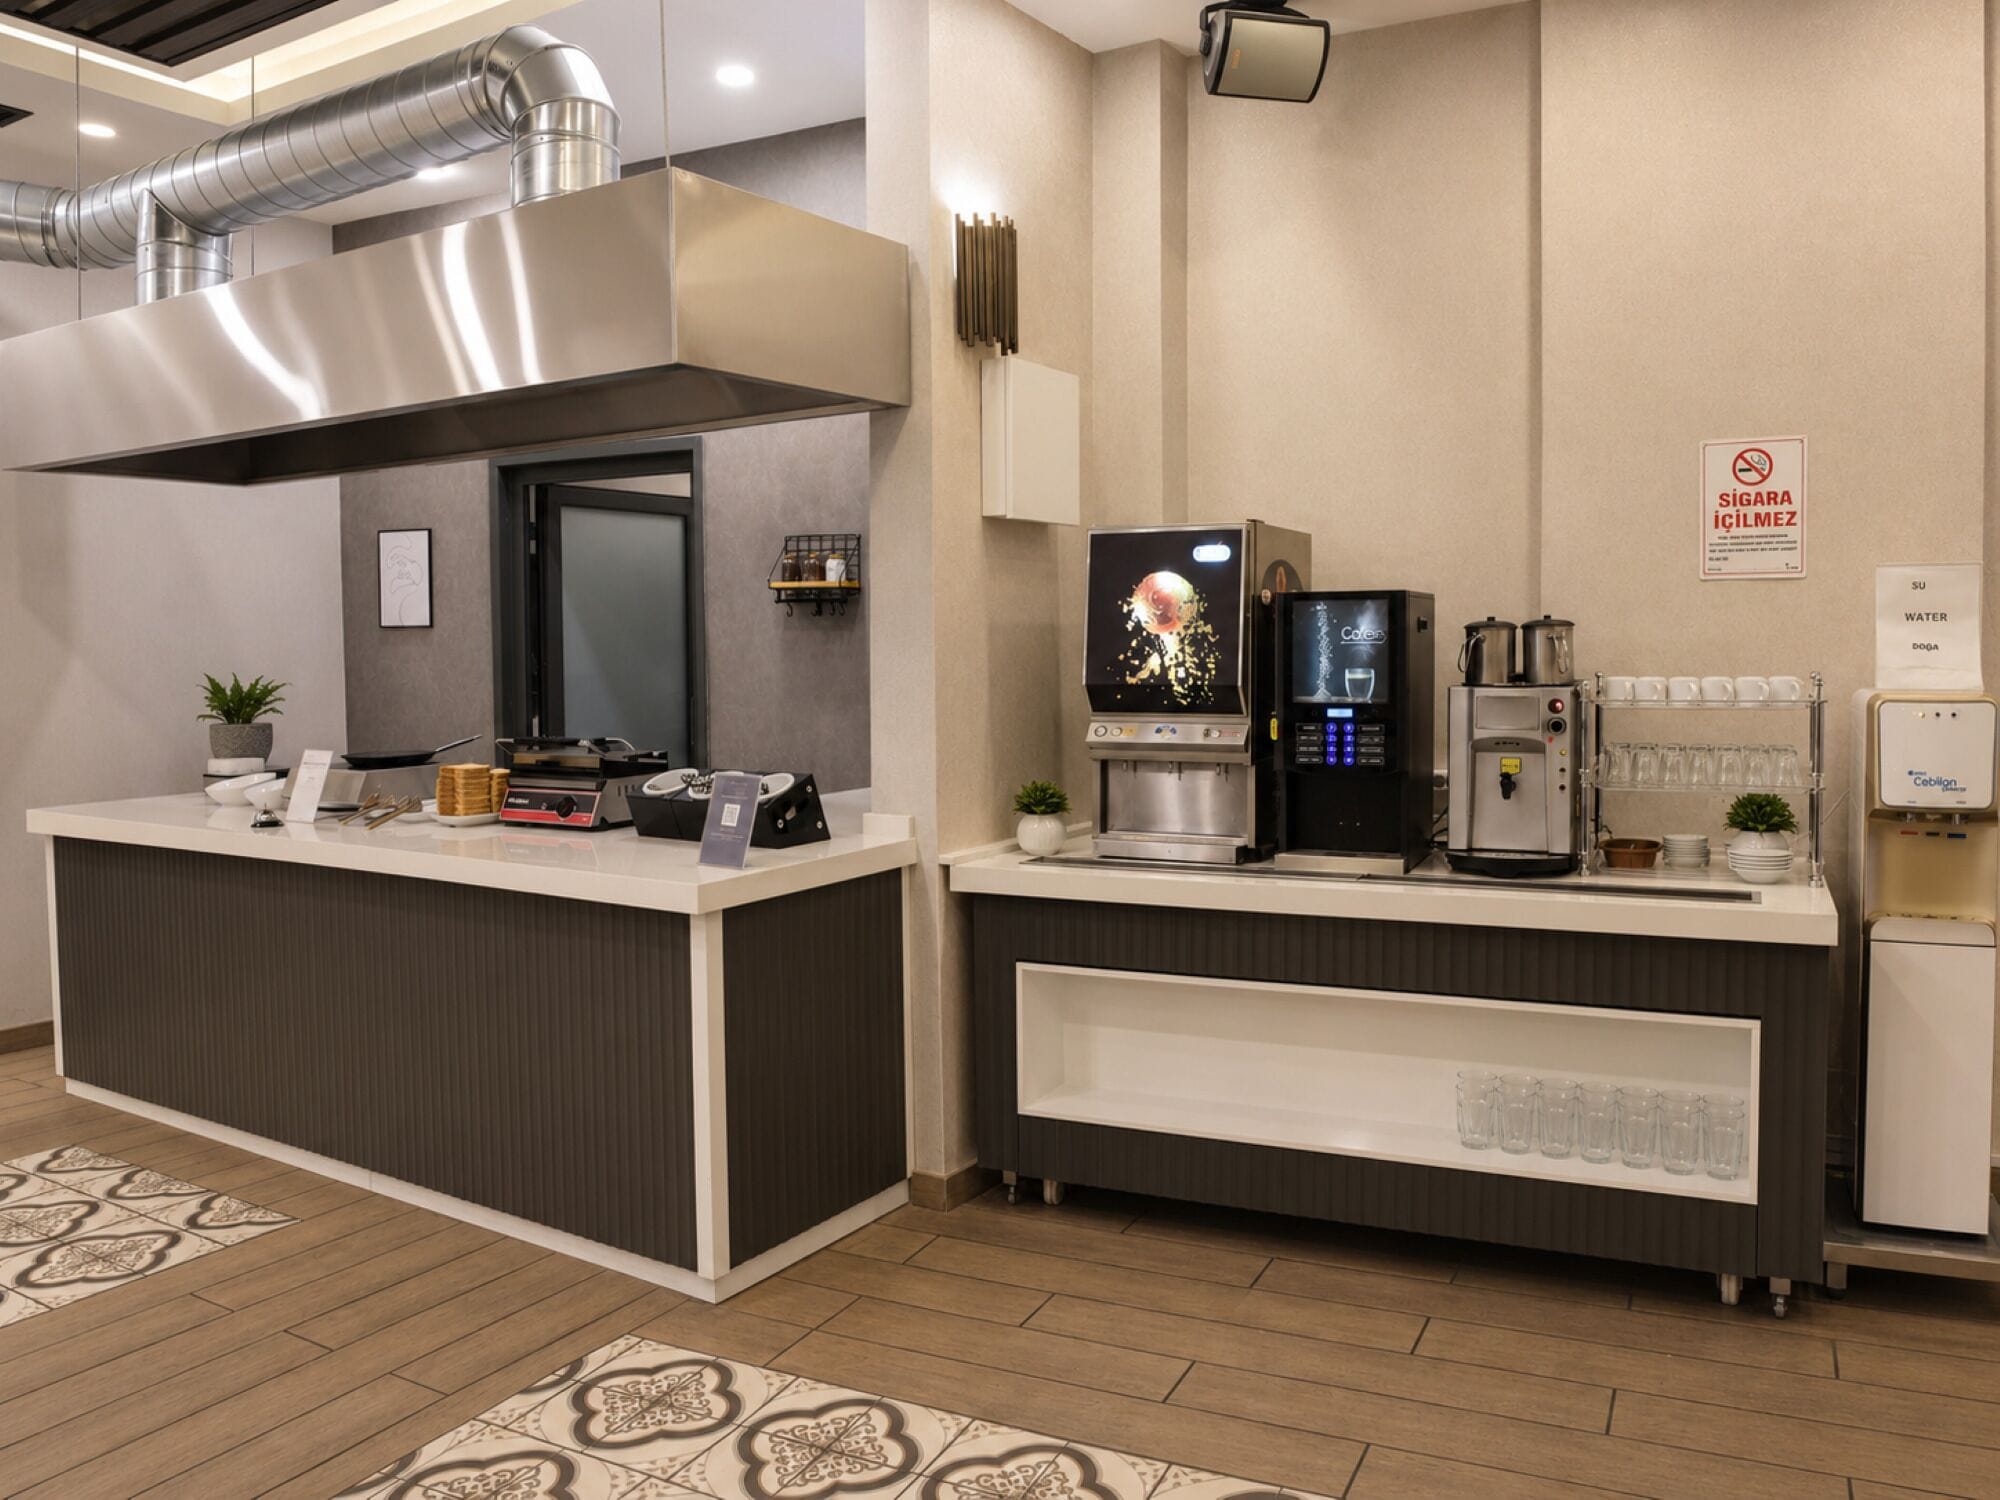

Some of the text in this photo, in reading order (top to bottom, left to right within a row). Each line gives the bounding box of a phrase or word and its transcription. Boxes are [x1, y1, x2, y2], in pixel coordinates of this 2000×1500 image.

[1719, 488, 1793, 508] SİGARA
[1714, 509, 1798, 533] İÇİLMEZ
[1911, 580, 1926, 591] SU
[1904, 612, 1948, 622] WATER
